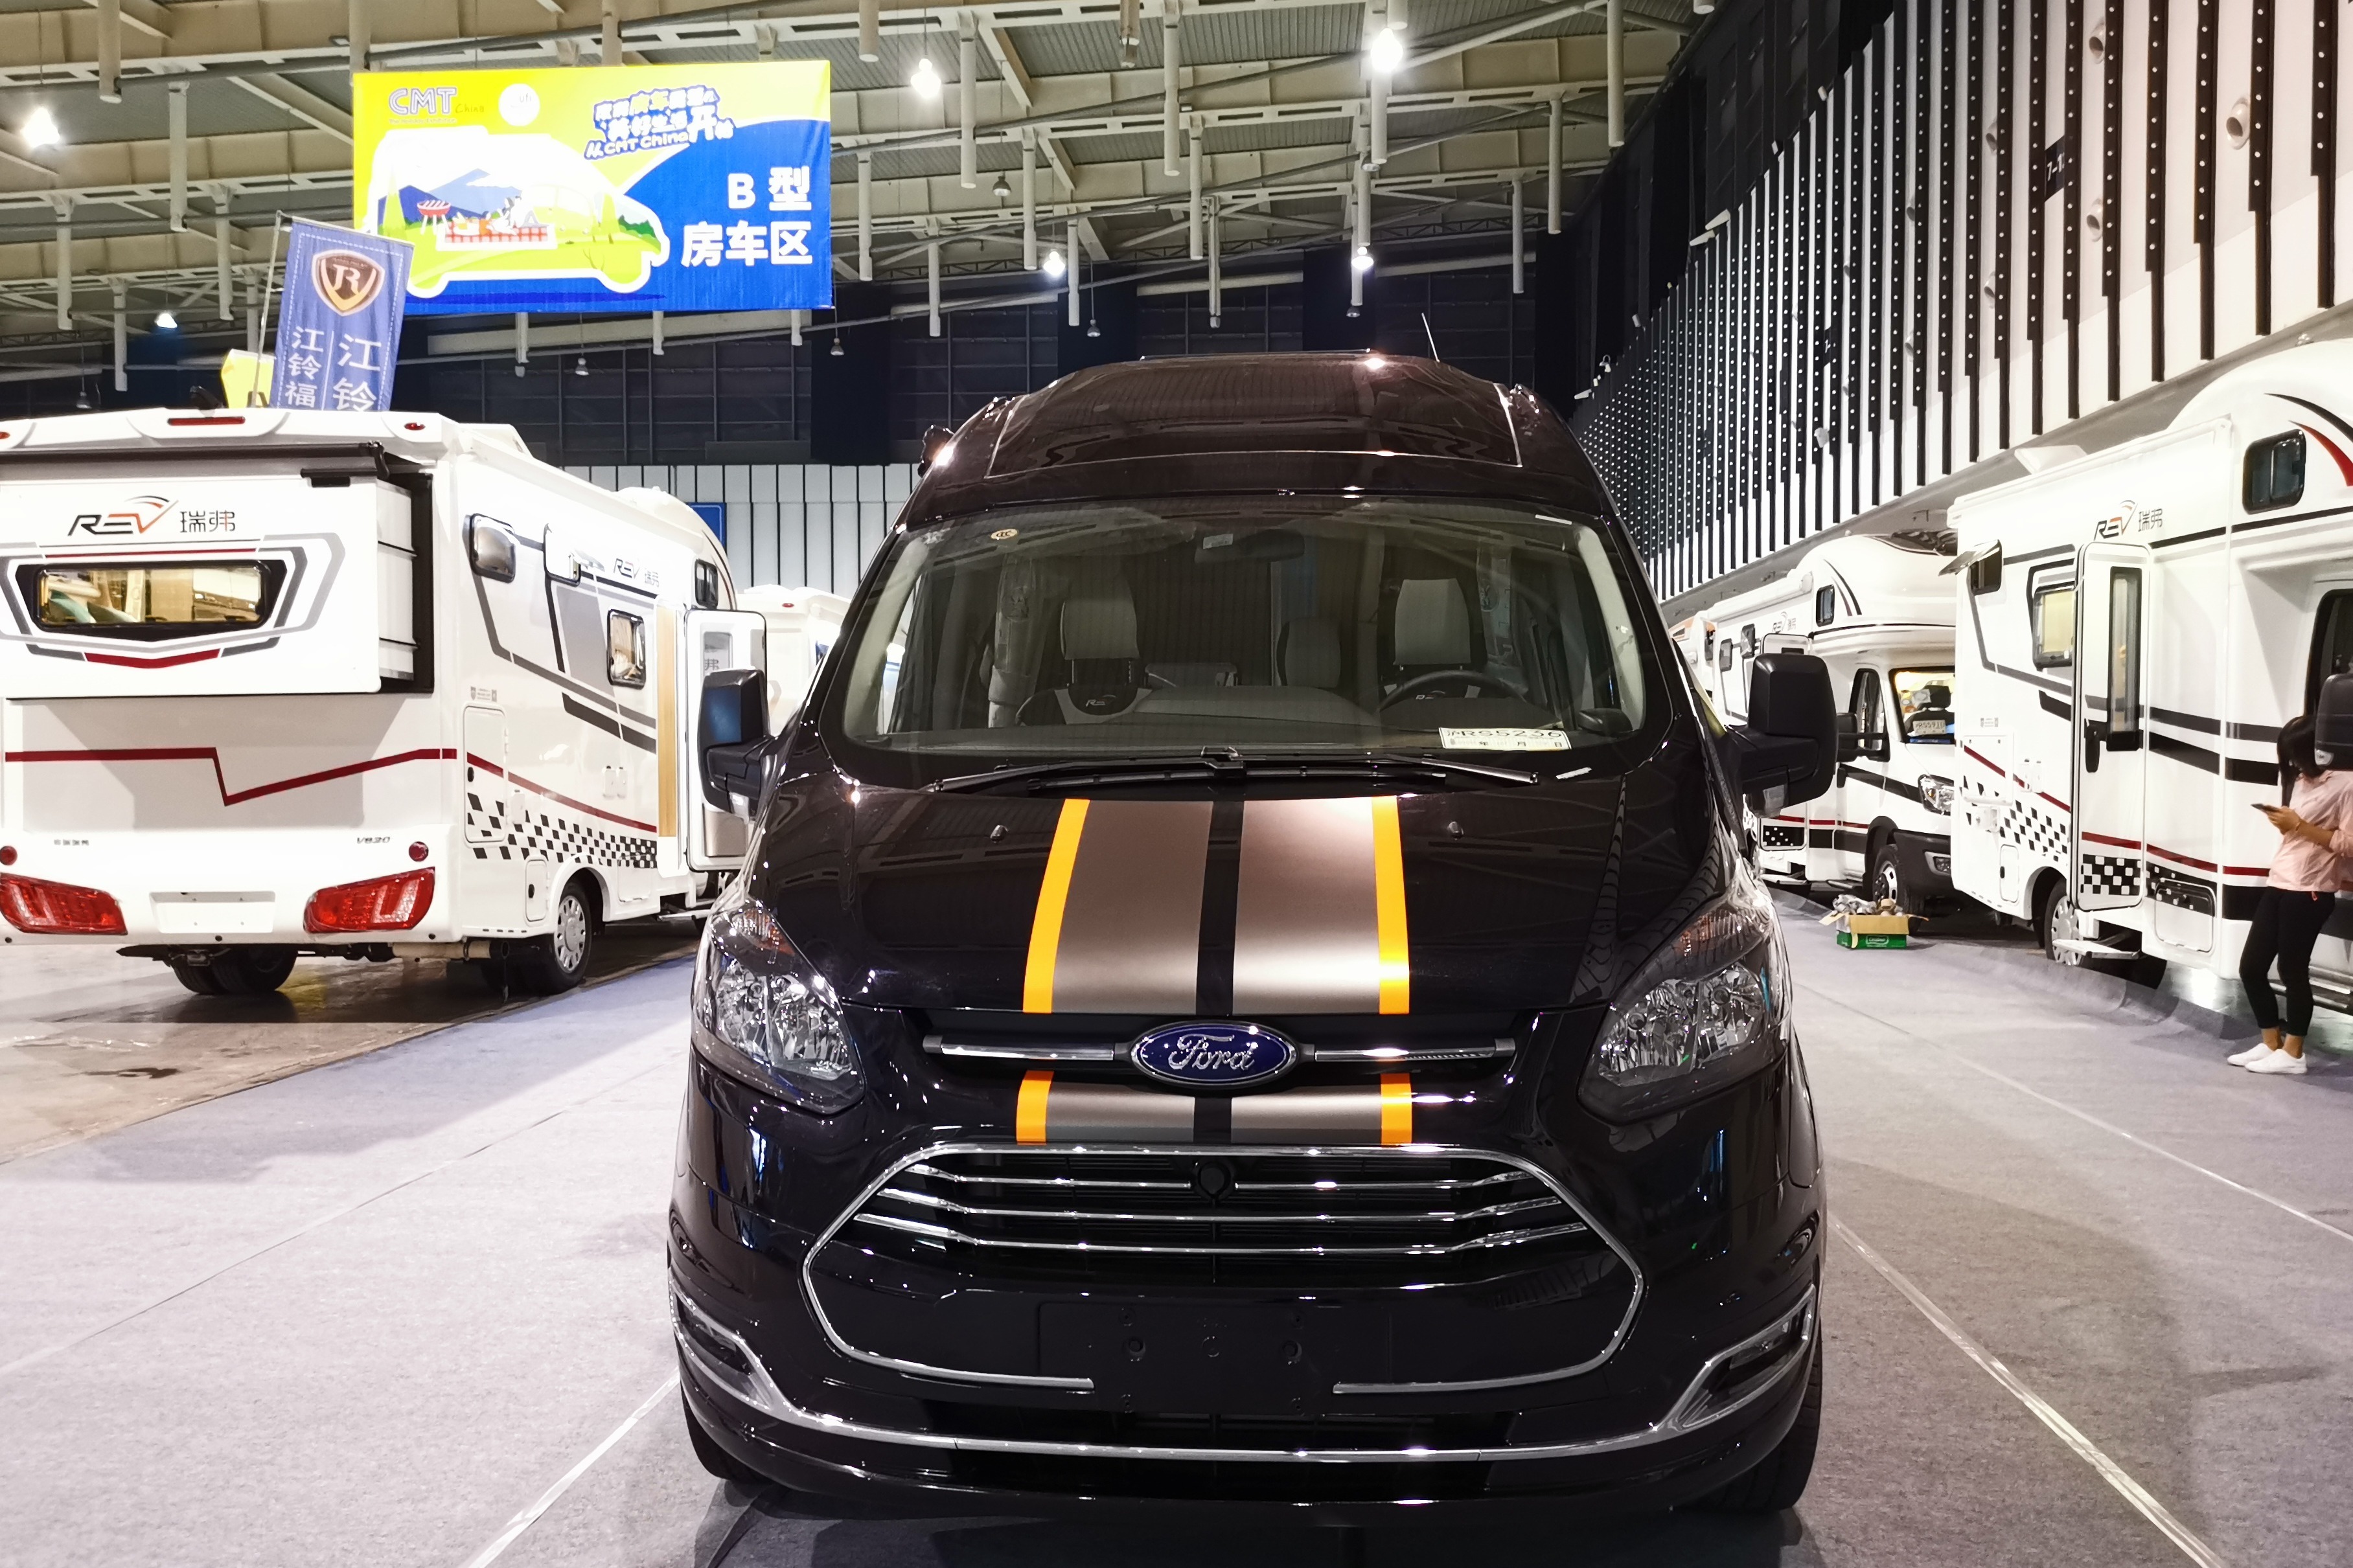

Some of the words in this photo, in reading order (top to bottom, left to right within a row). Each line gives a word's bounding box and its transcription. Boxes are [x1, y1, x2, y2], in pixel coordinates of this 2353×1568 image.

[388, 87, 457, 115] CMT
[640, 131, 689, 149] China
[681, 222, 813, 267] 房车区
[67, 500, 179, 537] REV
[179, 509, 236, 533] 瑞弗
[2093, 503, 2138, 541] REV
[2138, 508, 2163, 532] 瑞弗
[1168, 1034, 1258, 1071] Ford
